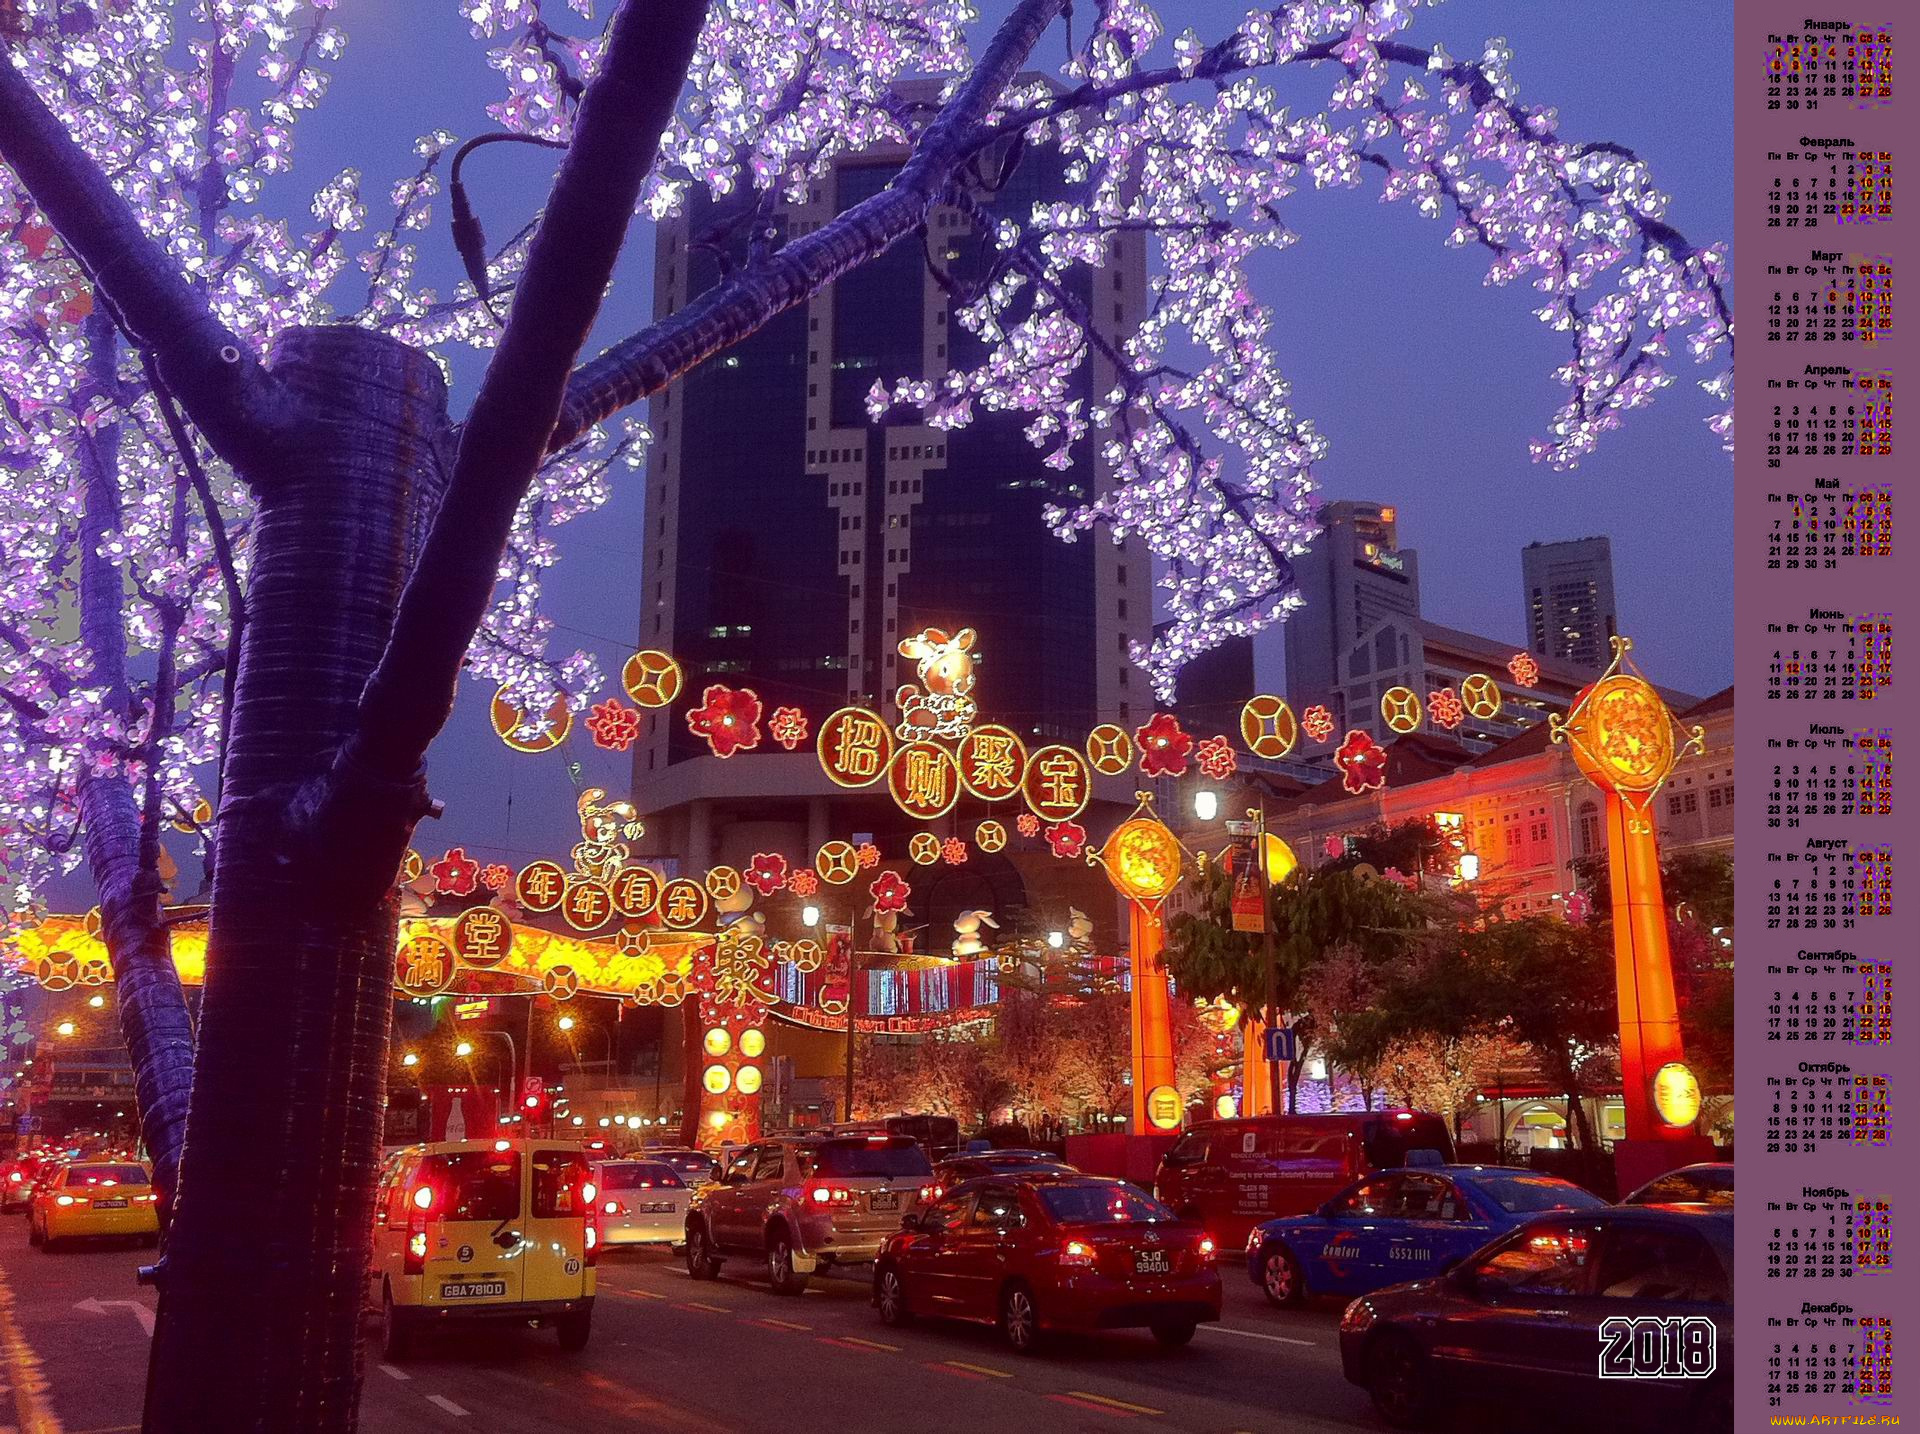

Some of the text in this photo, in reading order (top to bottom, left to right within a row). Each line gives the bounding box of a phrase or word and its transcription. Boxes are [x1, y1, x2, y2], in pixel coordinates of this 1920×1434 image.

[462, 1247, 470, 1256] 5
[1323, 1244, 1360, 1258] Comfort
[567, 1260, 578, 1272] 70
